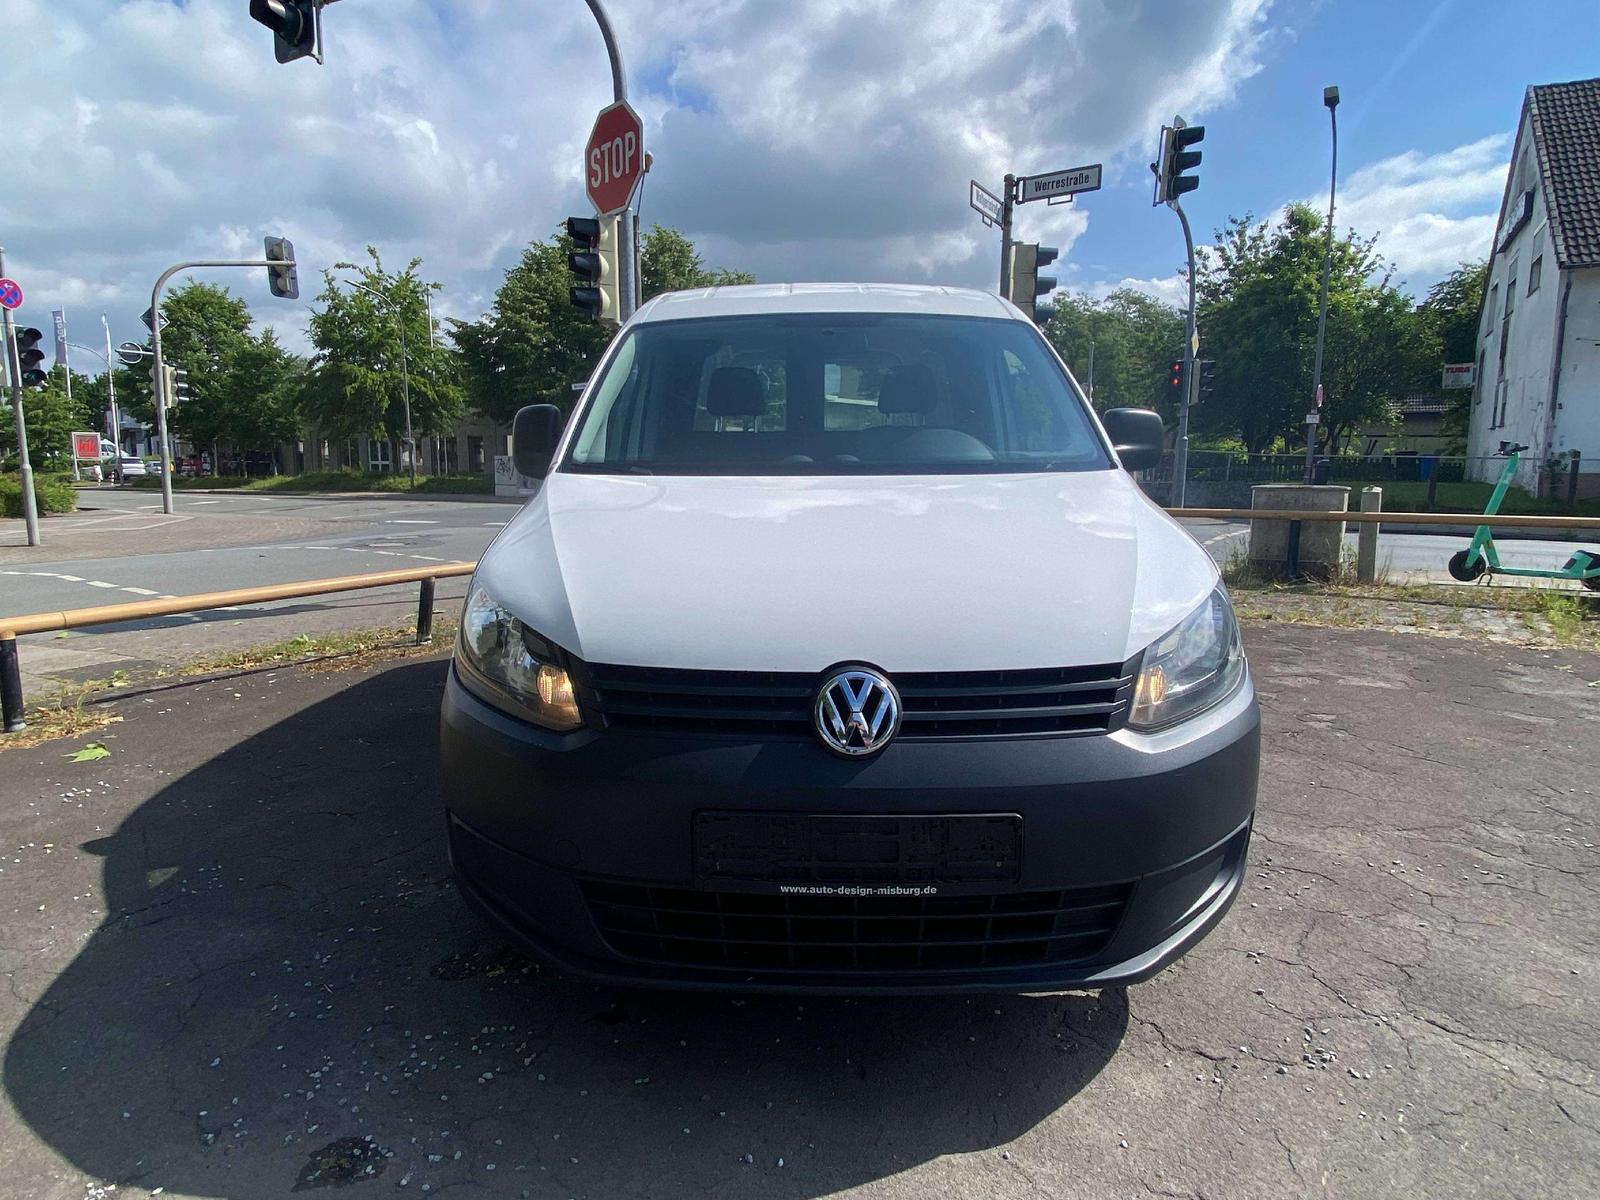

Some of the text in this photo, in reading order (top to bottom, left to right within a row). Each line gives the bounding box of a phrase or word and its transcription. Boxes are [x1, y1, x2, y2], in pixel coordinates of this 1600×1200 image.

[591, 131, 636, 188] STOP
[1034, 172, 1090, 192] Werrestraße
[819, 674, 894, 749] VW
[780, 885, 938, 897] www.auto-design-misburg.de
